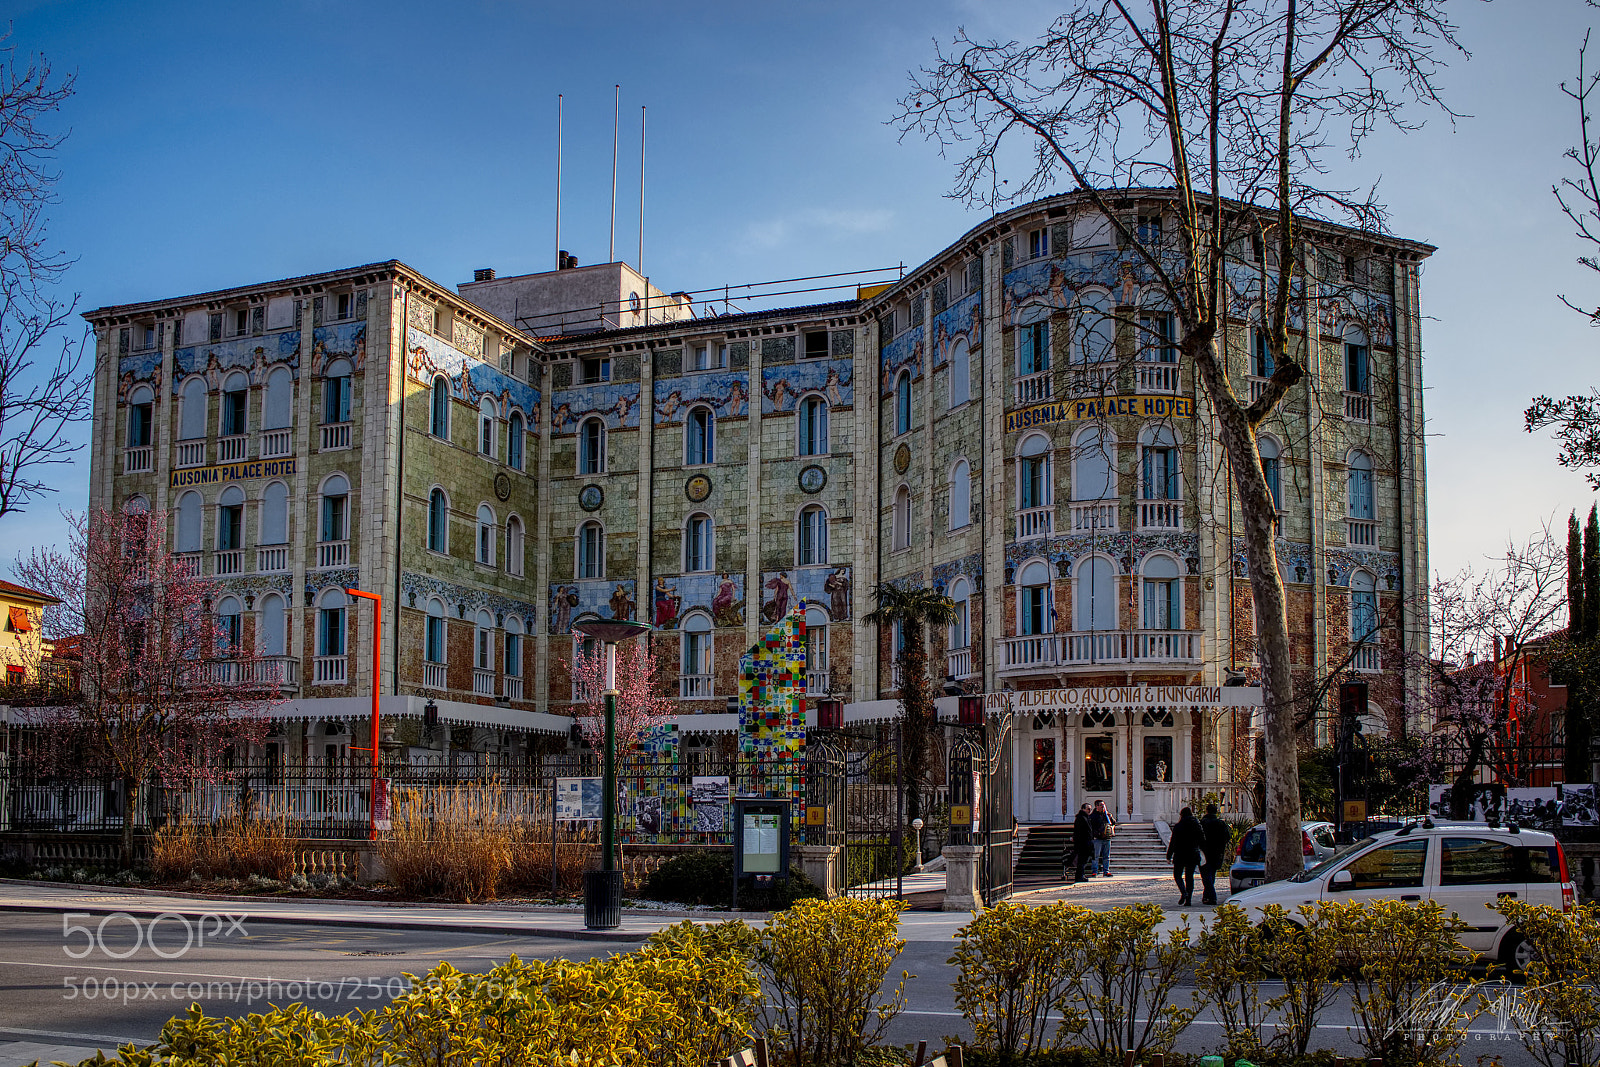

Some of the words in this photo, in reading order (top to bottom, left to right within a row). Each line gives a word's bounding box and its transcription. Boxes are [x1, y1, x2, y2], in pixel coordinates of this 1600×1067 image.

[1008, 405, 1067, 432] AUSONIA
[1076, 399, 1139, 419] PALACE
[1144, 399, 1193, 417] HOTEL
[172, 469, 219, 486] AUSONIA
[222, 463, 262, 481] PALACE
[264, 460, 297, 476] HOTEL
[979, 692, 1014, 709] ANDE
[1019, 688, 1079, 707] ALBERGO
[1082, 687, 1141, 704] AUSONIA
[1145, 687, 1154, 702] &
[1157, 686, 1221, 703] HUNGARIA
